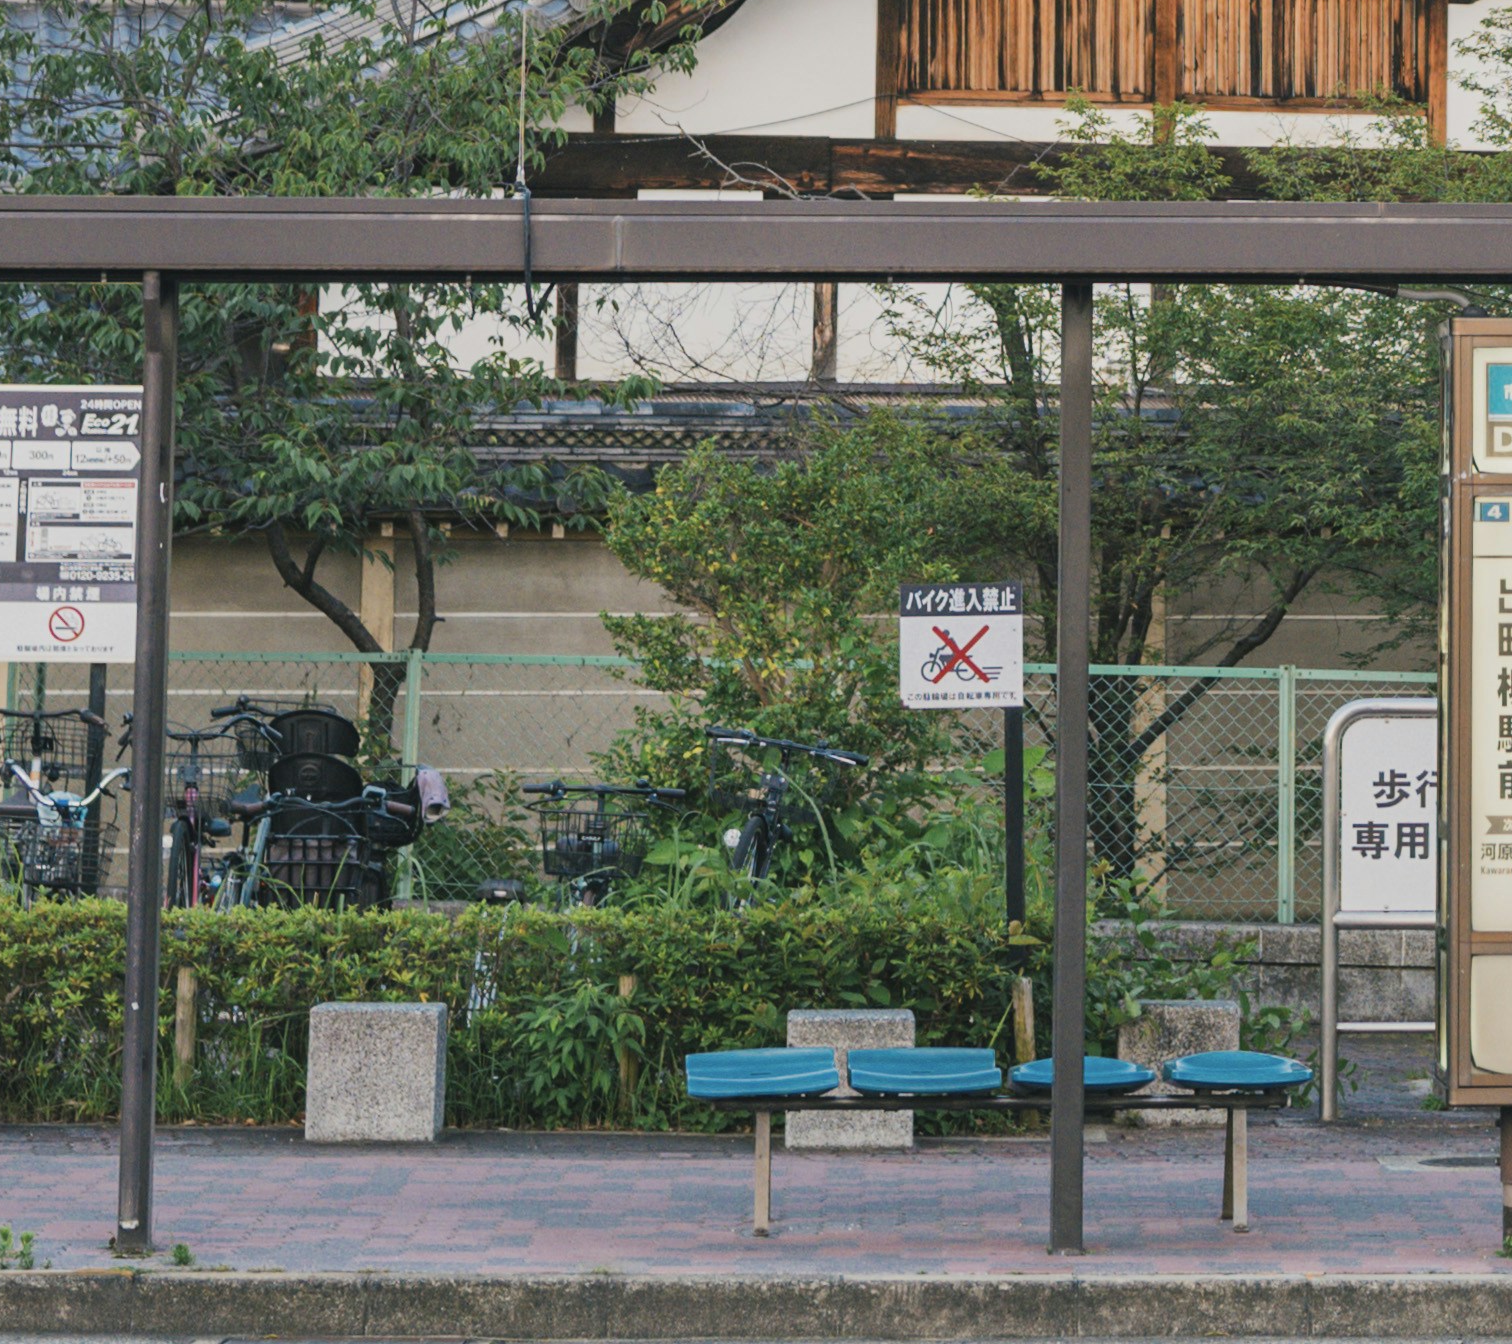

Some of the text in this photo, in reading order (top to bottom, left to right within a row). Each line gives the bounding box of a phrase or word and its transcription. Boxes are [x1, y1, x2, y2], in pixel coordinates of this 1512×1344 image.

[1487, 505, 1502, 519] 4
[906, 587, 1016, 612] バイク進入禁止
[1352, 821, 1430, 859] 専用
